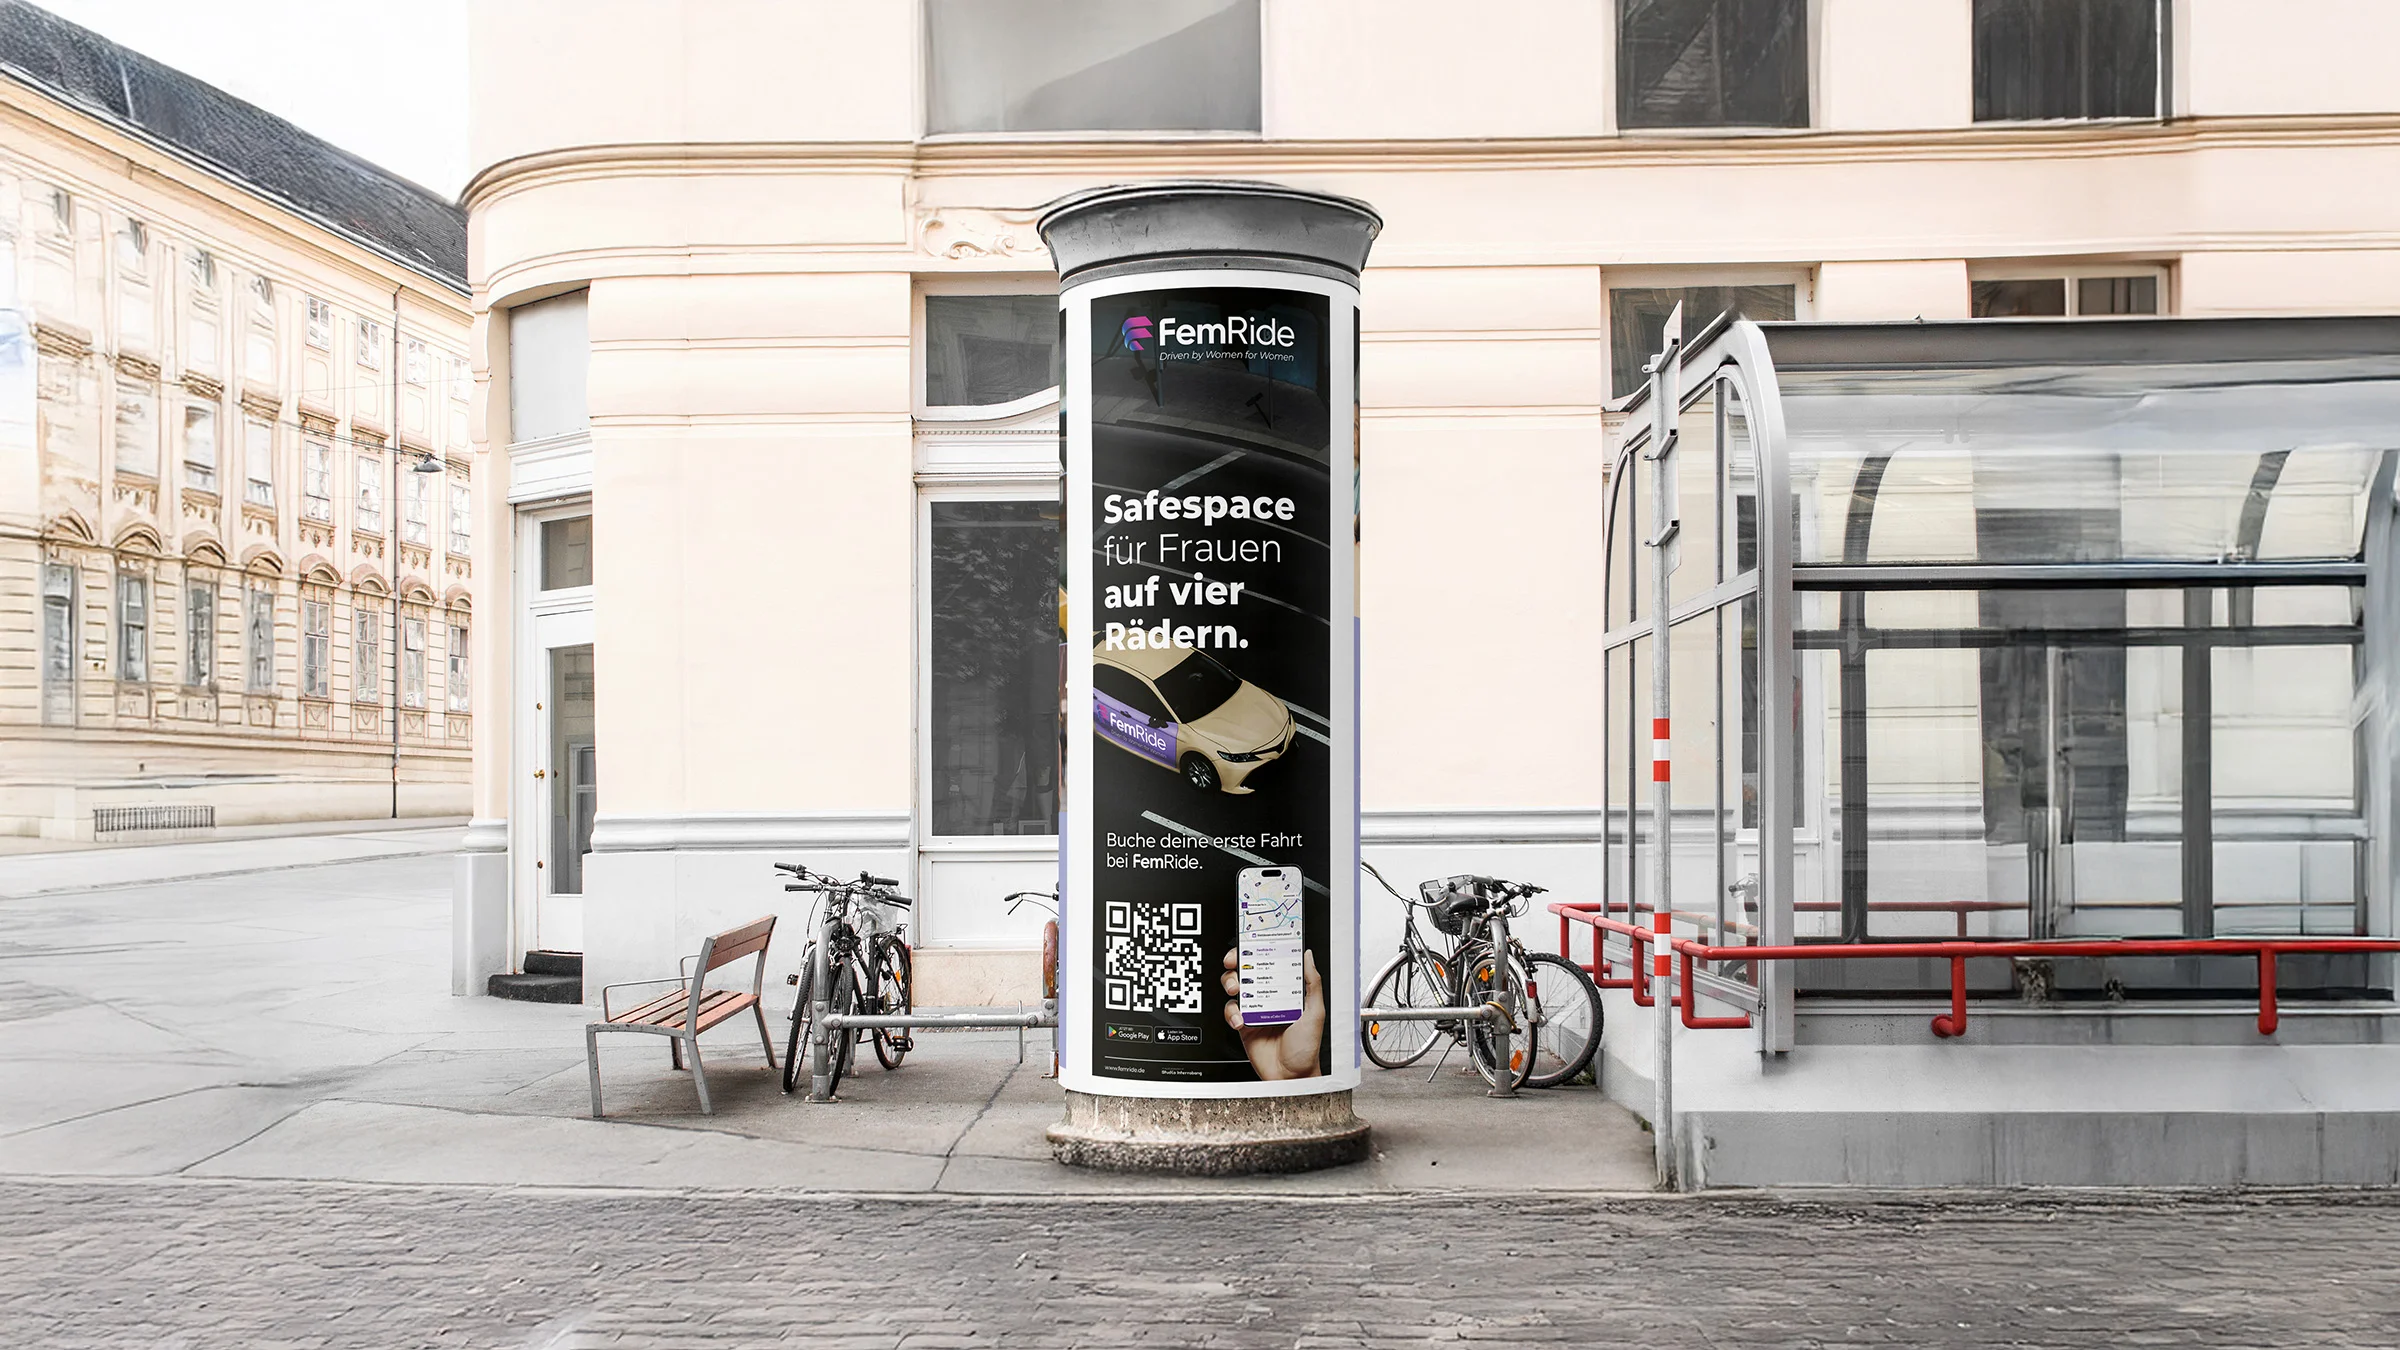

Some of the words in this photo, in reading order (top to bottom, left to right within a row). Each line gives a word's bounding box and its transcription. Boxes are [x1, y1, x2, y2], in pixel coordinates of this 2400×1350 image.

[1159, 316, 1295, 347] FemRide
[1159, 351, 1190, 361] Driven
[1191, 350, 1203, 361] by
[1205, 350, 1244, 360] Women
[1244, 350, 1258, 360] for
[1259, 351, 1295, 362] Women
[1104, 489, 1295, 526] Safespace
[1104, 535, 1147, 566] für
[1160, 533, 1281, 563] Frauen
[1104, 575, 1160, 609] auf
[1169, 572, 1245, 606] vier
[1105, 618, 1249, 651] Rädern.
[1109, 712, 1167, 751] FemRide
[1106, 832, 1156, 848] Buche
[1160, 832, 1209, 848] deine
[1213, 834, 1256, 848] erste
[1260, 832, 1303, 848] Fahrt
[1106, 853, 1129, 868] bei
[1133, 853, 1203, 869] FemRide.
[1118, 1030, 1137, 1040] Google
[1138, 1031, 1150, 1041] Play
[1167, 1034, 1180, 1042] App
